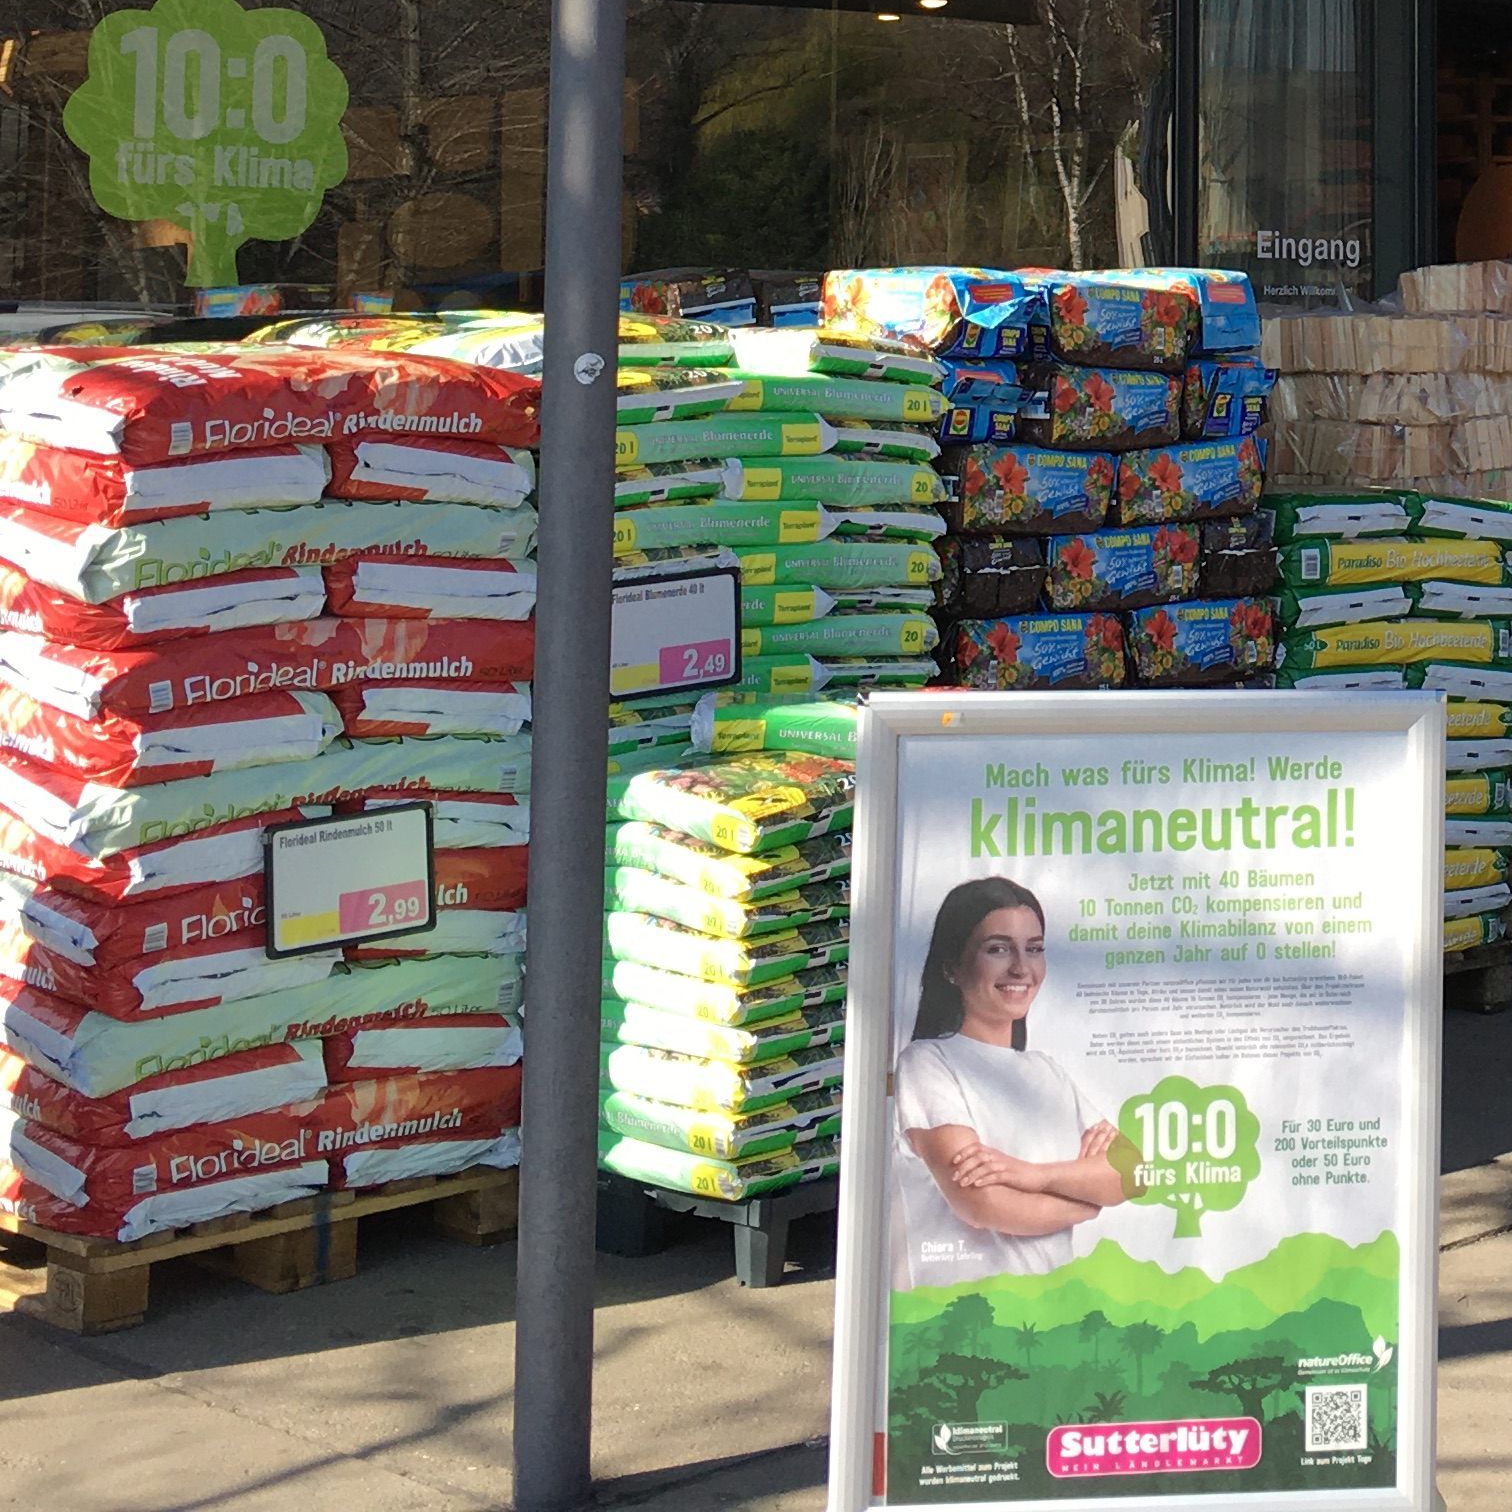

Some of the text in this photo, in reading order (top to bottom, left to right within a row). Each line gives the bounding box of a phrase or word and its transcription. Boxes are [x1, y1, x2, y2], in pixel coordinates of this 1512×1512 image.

[119, 25, 307, 145] 10:0
[114, 142, 314, 190] fürs Klima
[1257, 230, 1360, 267] Eingang
[1263, 285, 1299, 296] Herzlich
[907, 399, 921, 412] 20
[204, 407, 483, 450] Florideal Rindenmulch
[915, 481, 928, 493] 20
[1337, 557, 1383, 570] Paradiso
[1386, 549, 1406, 569] Bio
[904, 630, 919, 643] 20
[1028, 619, 1083, 634] COMPO SANA
[1336, 636, 1380, 650] Paradiso
[1384, 630, 1405, 650] Bio
[682, 648, 725, 679] 2,49
[184, 656, 473, 706] Florideal Rindenmulch
[779, 729, 843, 742] UNIVERSAL
[985, 755, 1343, 788] Mach was fürs Klima! Werde
[970, 787, 1355, 858] klimaneutral!
[279, 832, 317, 850] Florideal
[319, 825, 373, 843] Rindenmulch
[374, 821, 385, 834] 50
[1128, 868, 1315, 892] Jetzt mit 40 Bäumen
[367, 892, 420, 926] 2,99
[1079, 899, 1096, 917] 10
[1106, 897, 1165, 916] Tonnen
[1206, 892, 1325, 914] kompensieren
[1331, 892, 1363, 910] und
[1068, 918, 1372, 942] damit deine Klimabilanz von einem
[1105, 940, 1336, 968] ganzen Jahr auf 0 stellen!
[1133, 1099, 1237, 1163] 10:0
[1281, 1117, 1381, 1134] Für 30 Euro und
[169, 1107, 463, 1184] Florideal Rindenmulch
[693, 1135, 706, 1150] 20
[1274, 1134, 1388, 1154] 200 Vorteilspunkte
[1291, 1152, 1371, 1169] oder 50 Euro
[696, 1176, 709, 1190] 20
[1133, 1161, 1242, 1187] fürs Klima
[1291, 1171, 1370, 1186] ohne Punkte.
[921, 1241, 954, 1253] Chiara
[1297, 1353, 1374, 1368] natureOffice
[1059, 1425, 1250, 1458] Sutterlüty
[993, 1461, 1019, 1471] Projekt
[1061, 1455, 1244, 1473] MEIN LÄNDLEMARKT
[1300, 1457, 1314, 1466] Link
[1331, 1456, 1355, 1466] Projekt
